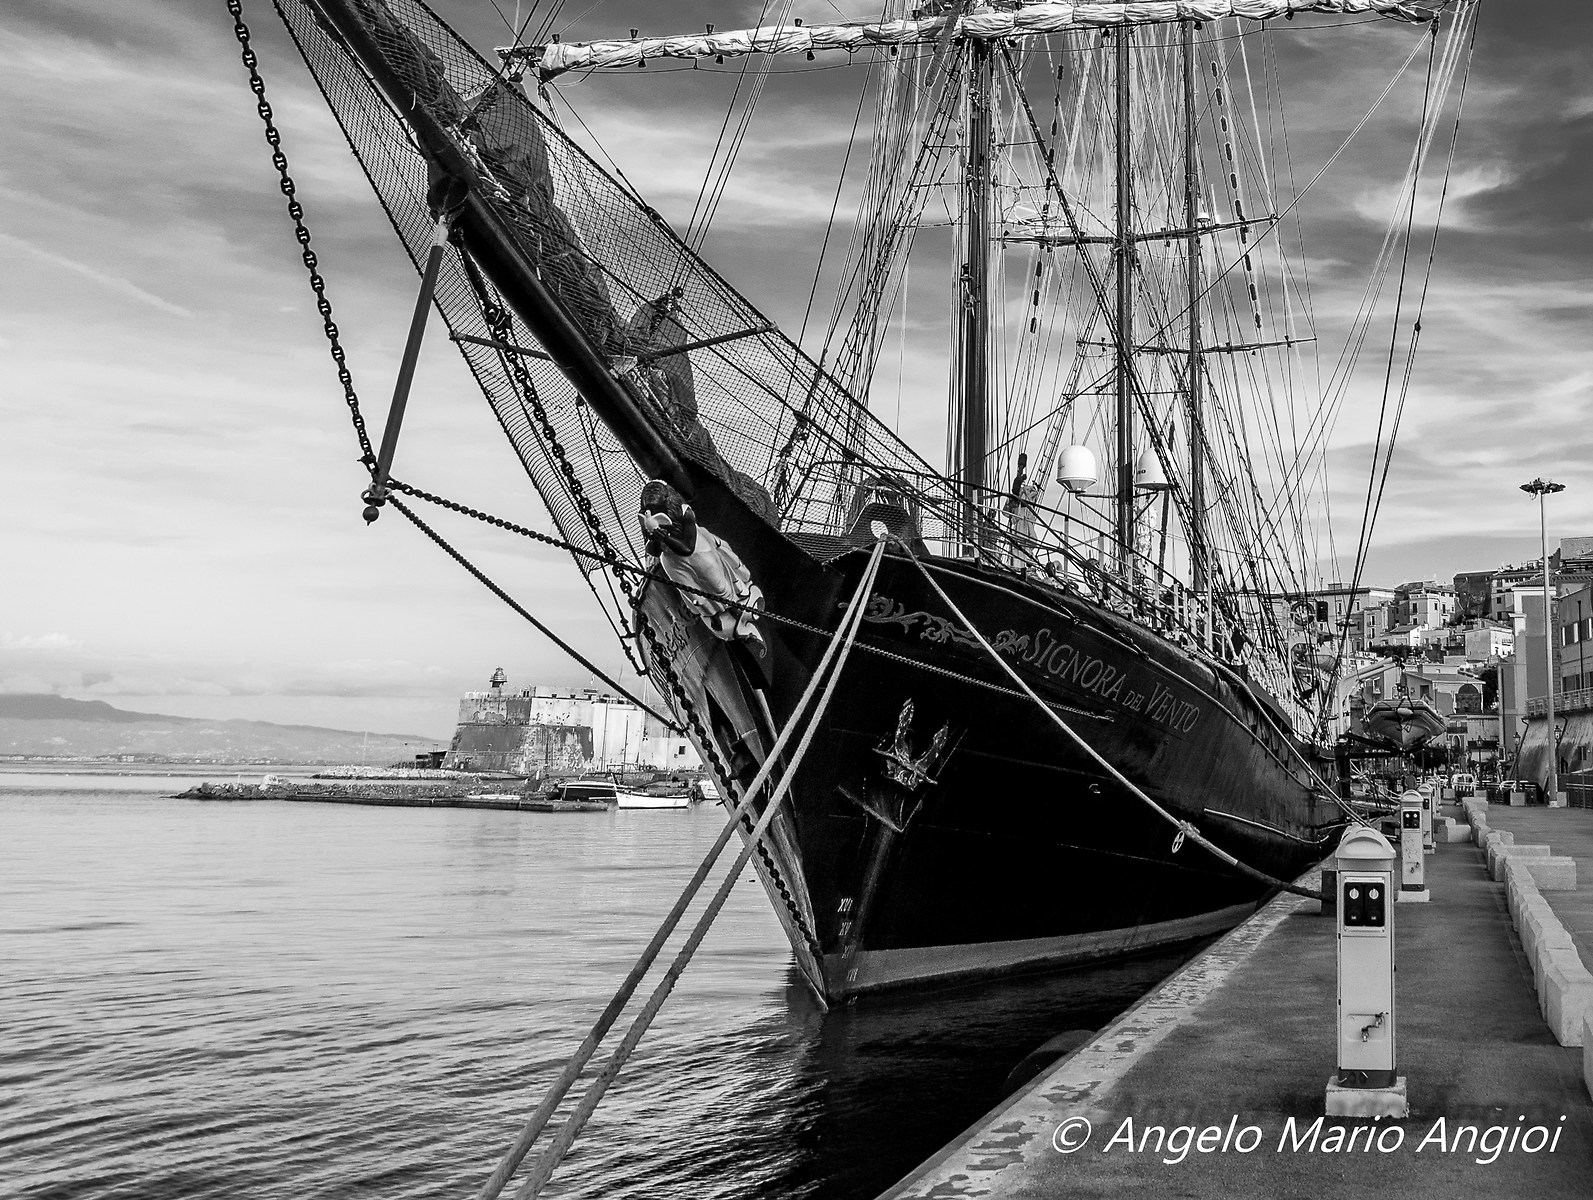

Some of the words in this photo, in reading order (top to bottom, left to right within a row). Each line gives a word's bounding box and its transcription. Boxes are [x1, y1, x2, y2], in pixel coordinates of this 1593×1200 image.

[1022, 628, 1127, 701] SIGNORA
[1121, 689, 1145, 712] DEL
[1144, 681, 1201, 733] VENTO
